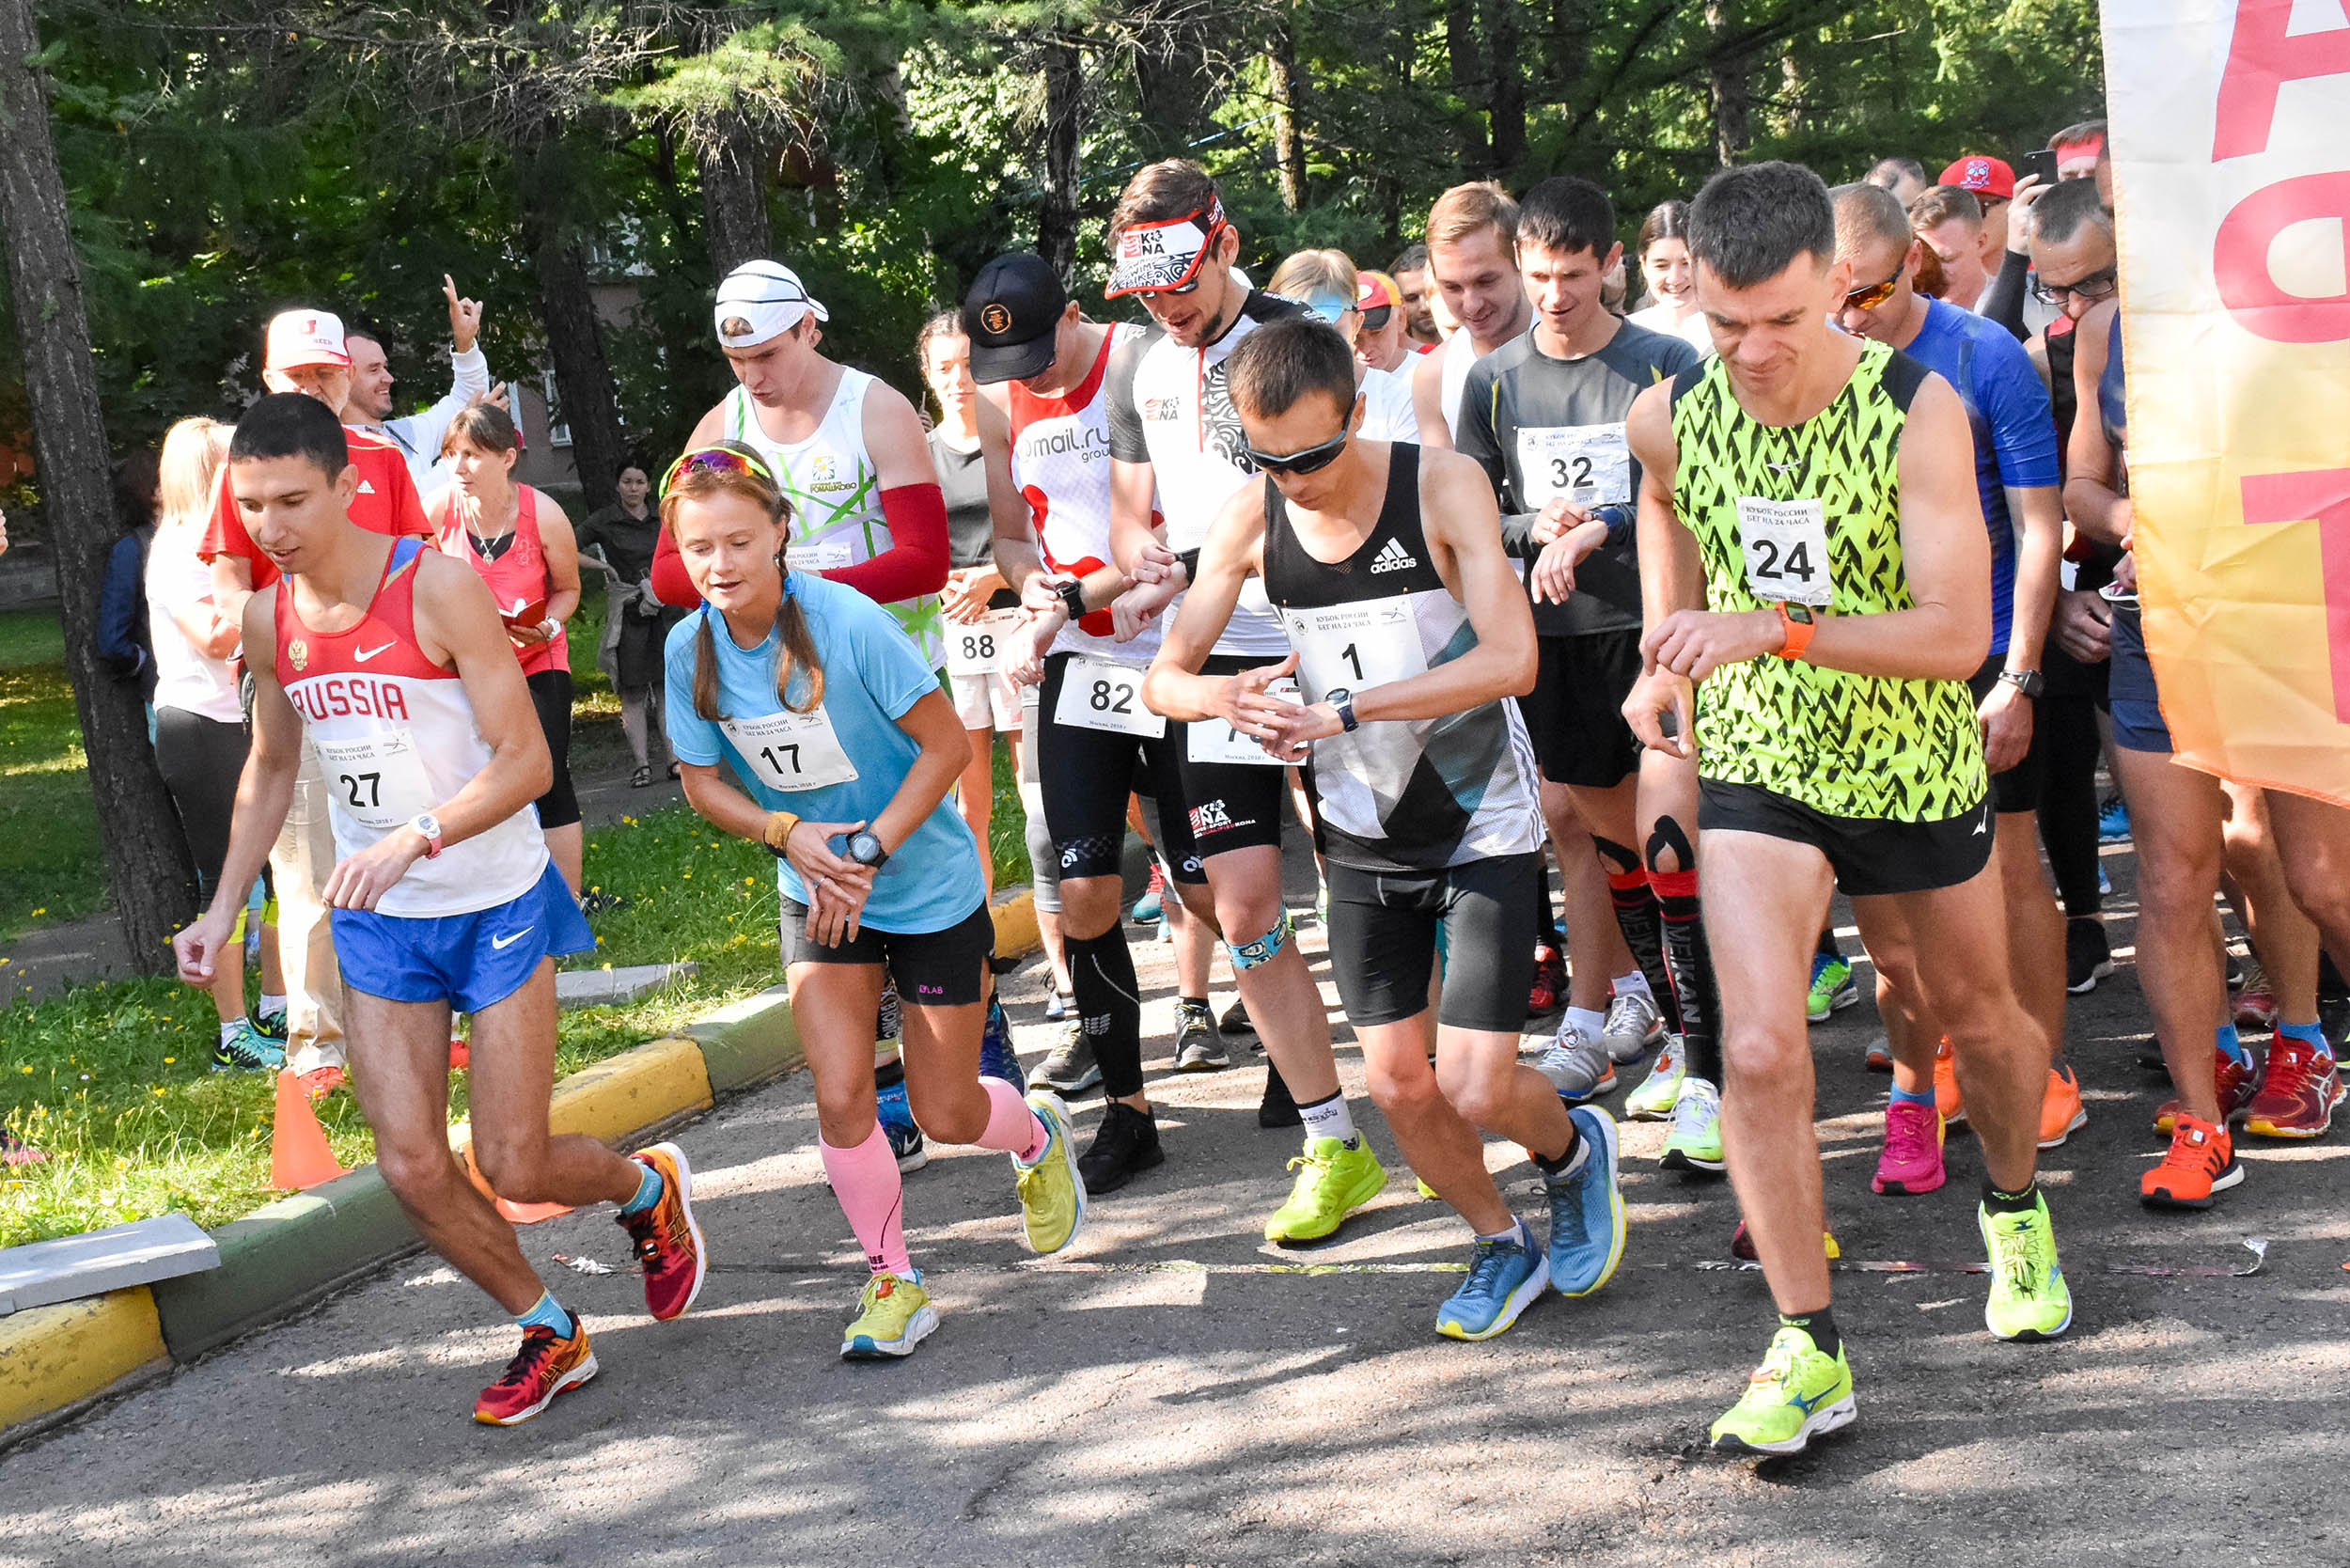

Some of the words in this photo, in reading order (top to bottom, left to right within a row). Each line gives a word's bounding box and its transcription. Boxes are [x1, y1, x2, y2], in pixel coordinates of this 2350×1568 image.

[1551, 457, 1593, 488] 32
[1746, 506, 1772, 516] КУБОК
[1774, 509, 1808, 517] РОССИИ
[1762, 517, 1773, 525] НА
[1786, 517, 1810, 525] ЧАСА
[1371, 557, 1417, 574] adidas
[1752, 540, 1815, 583] 24
[1316, 614, 1340, 622] КУБОК
[963, 635, 995, 659] 88
[1341, 643, 1363, 681] 1
[292, 680, 410, 725] RUSSIA
[1090, 681, 1134, 714] 82
[762, 718, 789, 729] РОССИИ
[345, 745, 371, 753] РОССИИ
[760, 744, 802, 775] 17
[340, 772, 381, 807] 27
[1666, 925, 1701, 1024] MEIKAN
